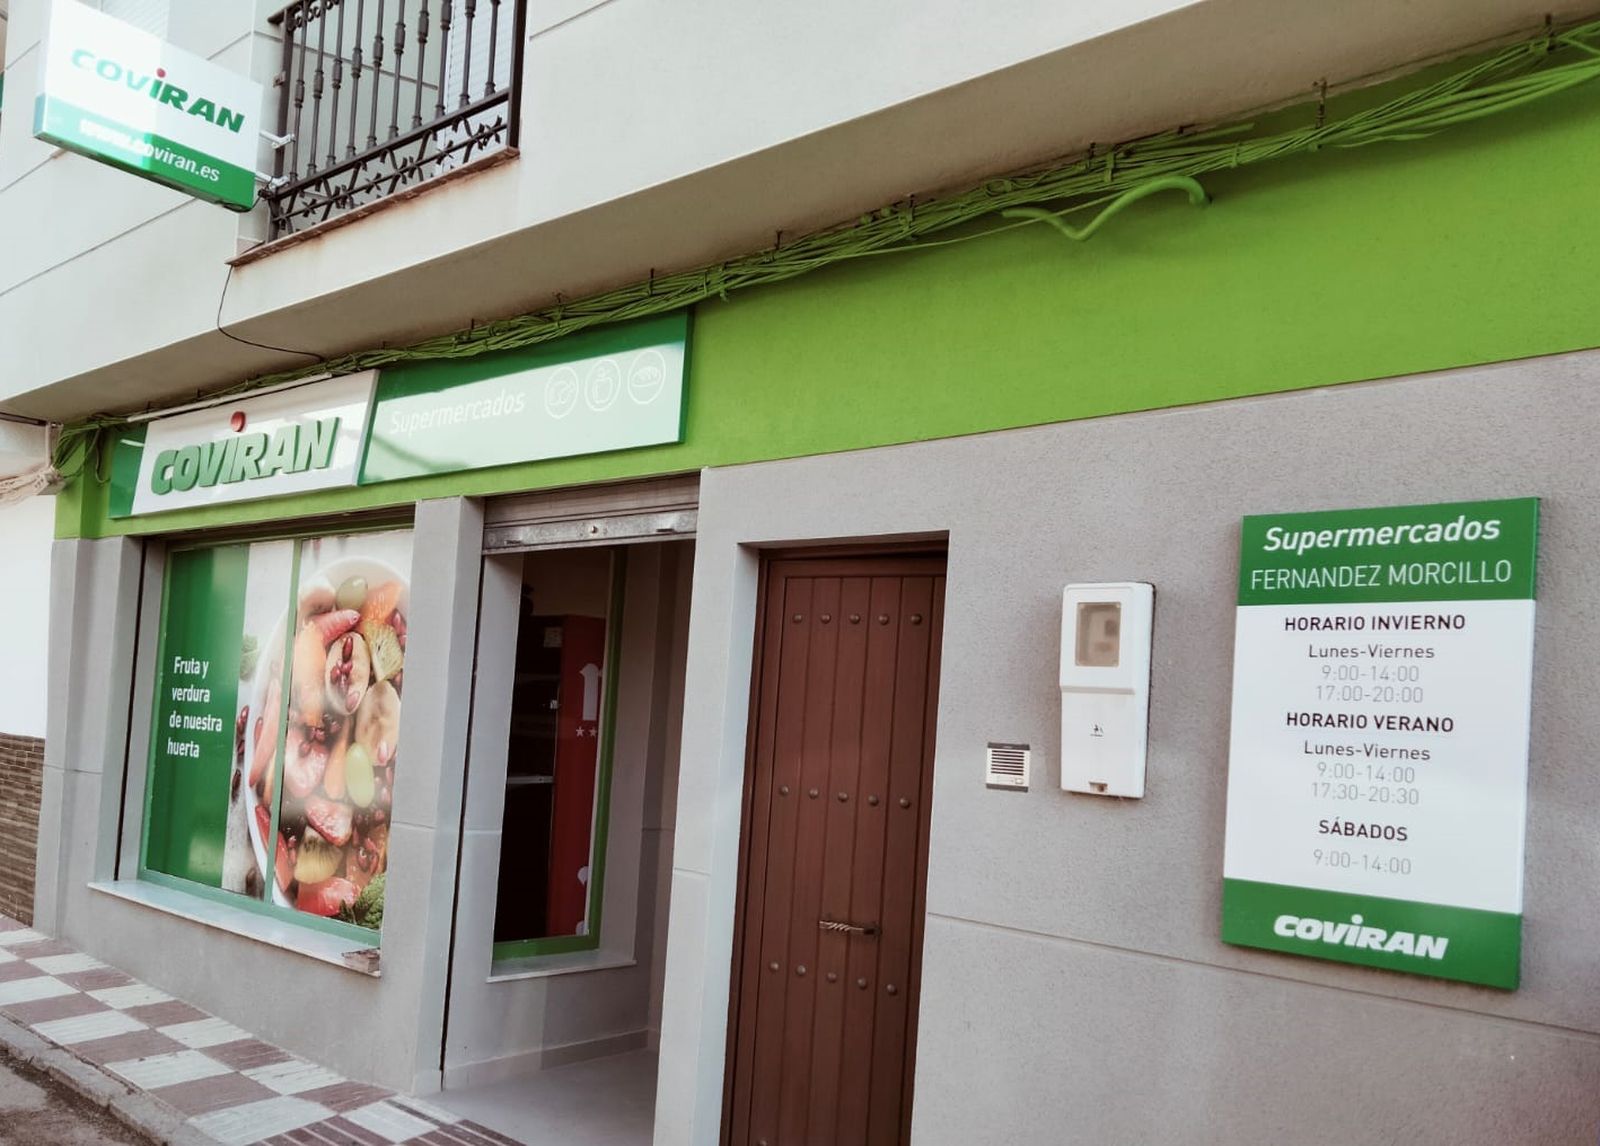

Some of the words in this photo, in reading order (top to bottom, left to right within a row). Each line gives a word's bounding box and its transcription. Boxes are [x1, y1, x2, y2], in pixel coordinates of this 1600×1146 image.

[390, 387, 526, 436] Supermercados
[1263, 515, 1502, 555] Supermercados
[1251, 565, 1381, 590] FERNANDEZ
[1388, 559, 1512, 586] MORCILLO
[1285, 616, 1365, 631] HORARIO
[1371, 614, 1466, 630] INVIERNO
[1308, 643, 1435, 658] Lunes-Viernes
[174, 656, 200, 674] Fruta
[202, 660, 209, 679] y
[1322, 664, 1419, 682] 9:00-14:00
[172, 684, 210, 702] verdura
[1316, 685, 1423, 703] 17:00-20:00
[169, 710, 181, 728] de
[183, 714, 222, 732] nuestra
[1286, 711, 1367, 728] HORARIO
[1374, 715, 1454, 732] VERANO
[167, 737, 200, 758] huerta
[1304, 740, 1431, 761] Lunes-Viernes
[1317, 762, 1415, 784] 9:00-14:00
[1311, 782, 1419, 805] 17:30-20:30
[1318, 816, 1408, 842] SÁBADOS
[1313, 849, 1411, 875] 9:00-14:00
